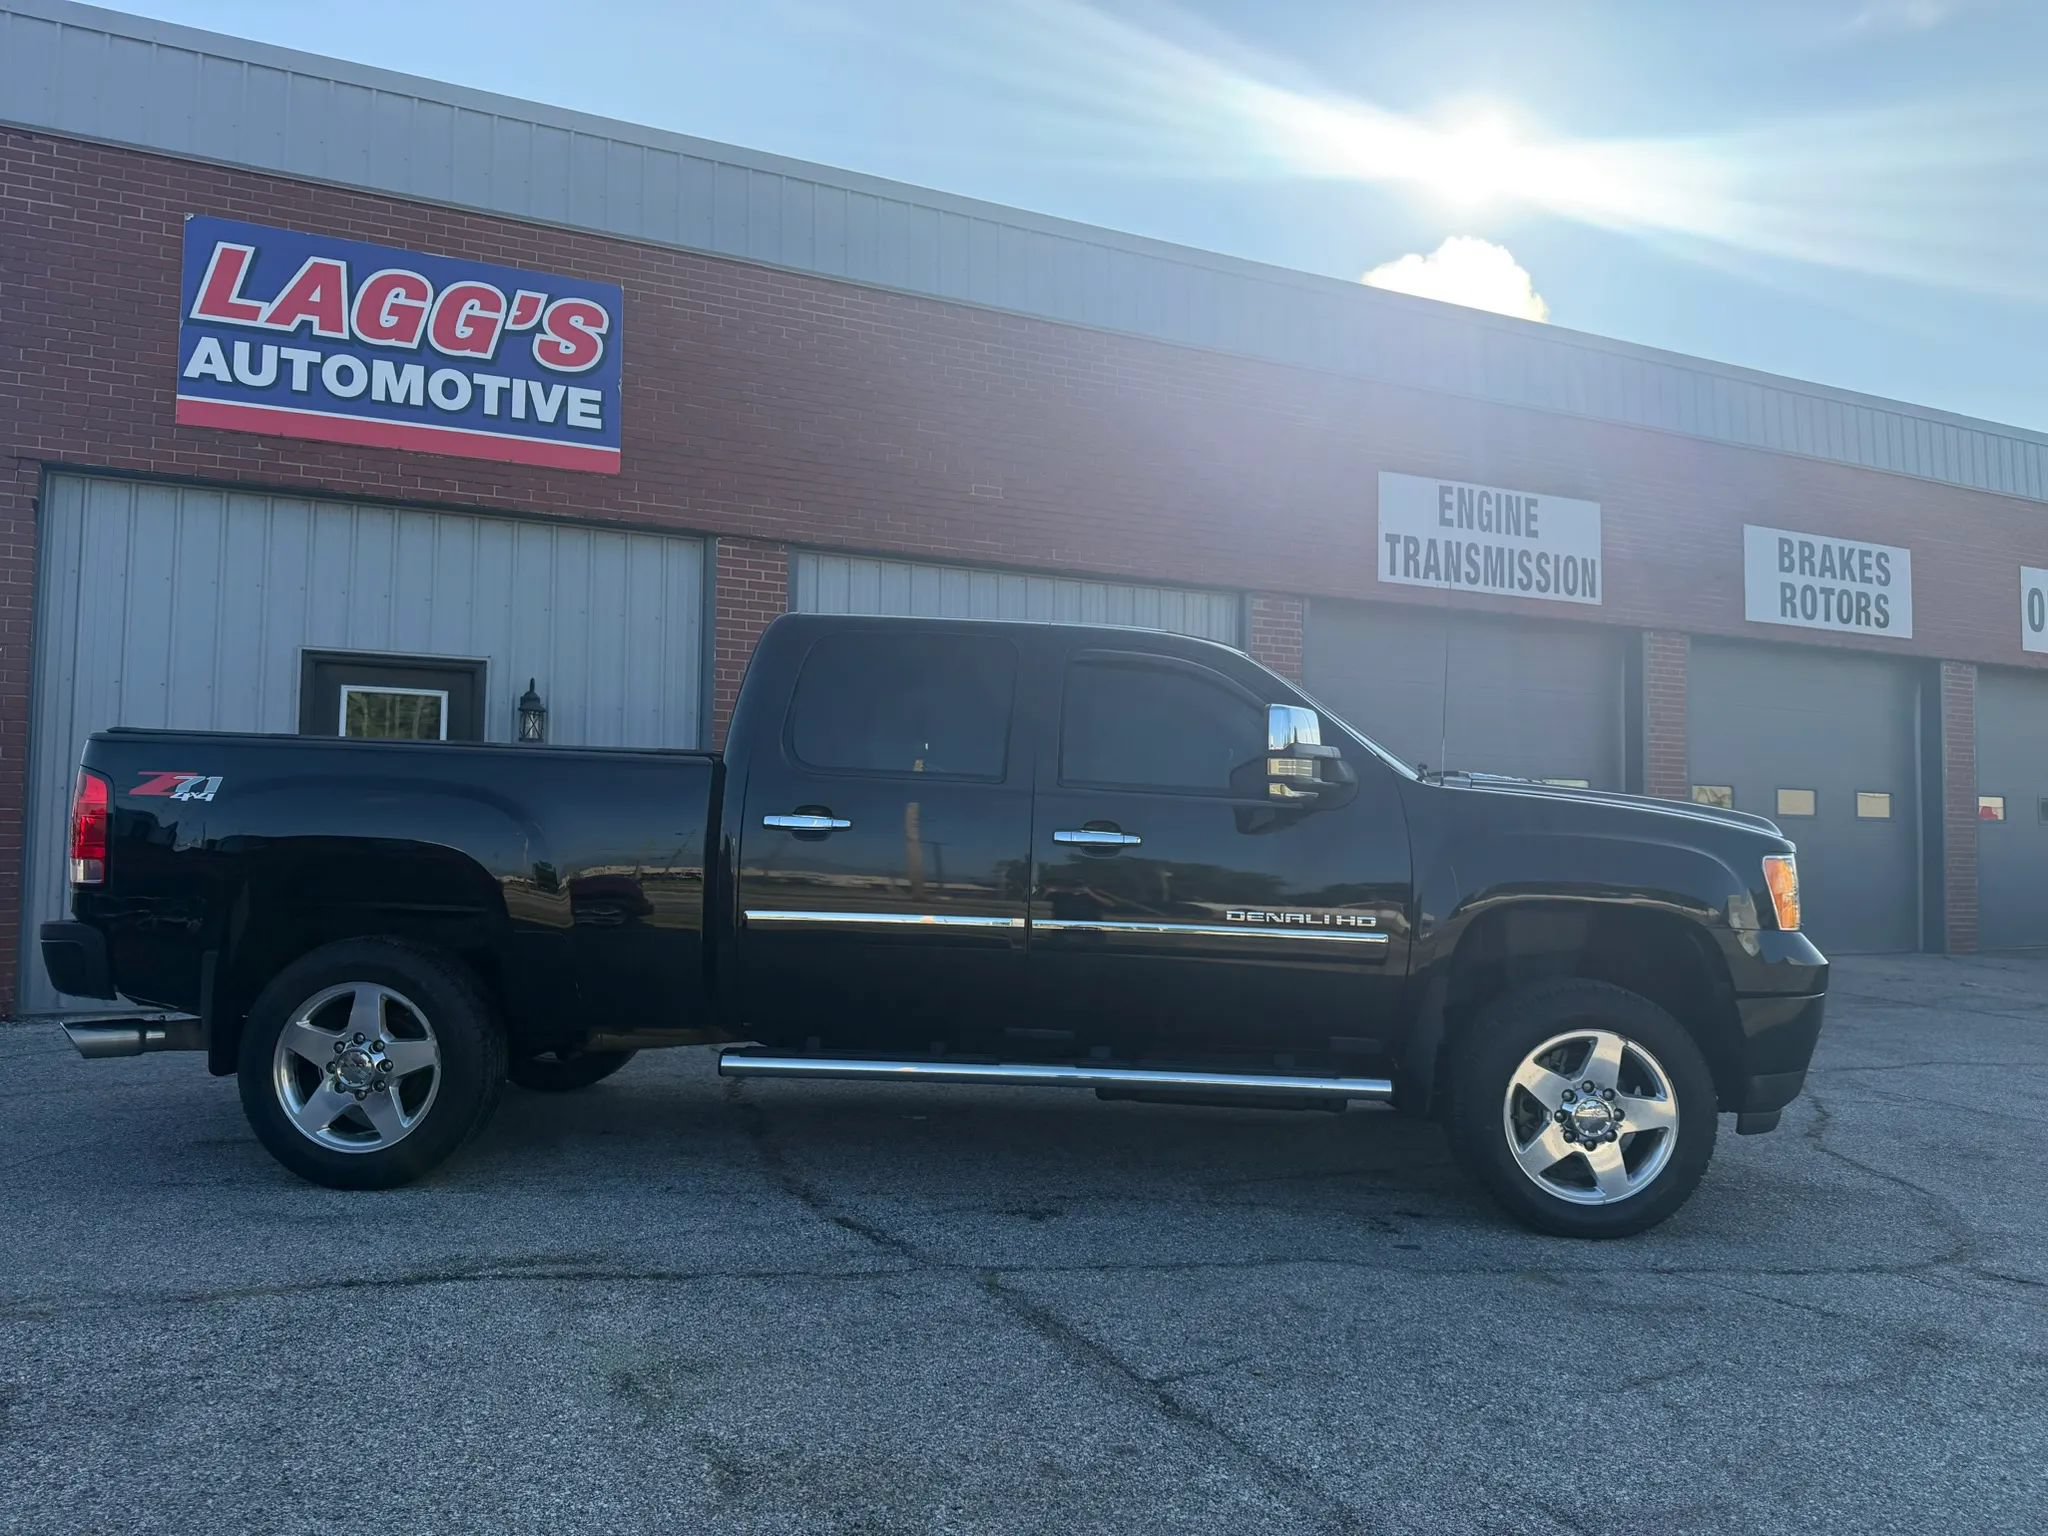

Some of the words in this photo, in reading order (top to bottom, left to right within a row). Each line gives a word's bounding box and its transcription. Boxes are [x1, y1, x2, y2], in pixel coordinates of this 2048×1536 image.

[190, 241, 609, 372] LAGG'S
[183, 336, 602, 429] AUTOMOTIVE
[1438, 485, 1539, 538] ENGINE
[1385, 533, 1596, 598] TRANSMISSION
[1778, 537, 1891, 586] BRAKES
[1780, 582, 1890, 628] ROTORS
[2027, 587, 2048, 633] O
[129, 771, 223, 796] Z71
[1226, 910, 1330, 925] DENALI
[1336, 915, 1377, 927] HD
